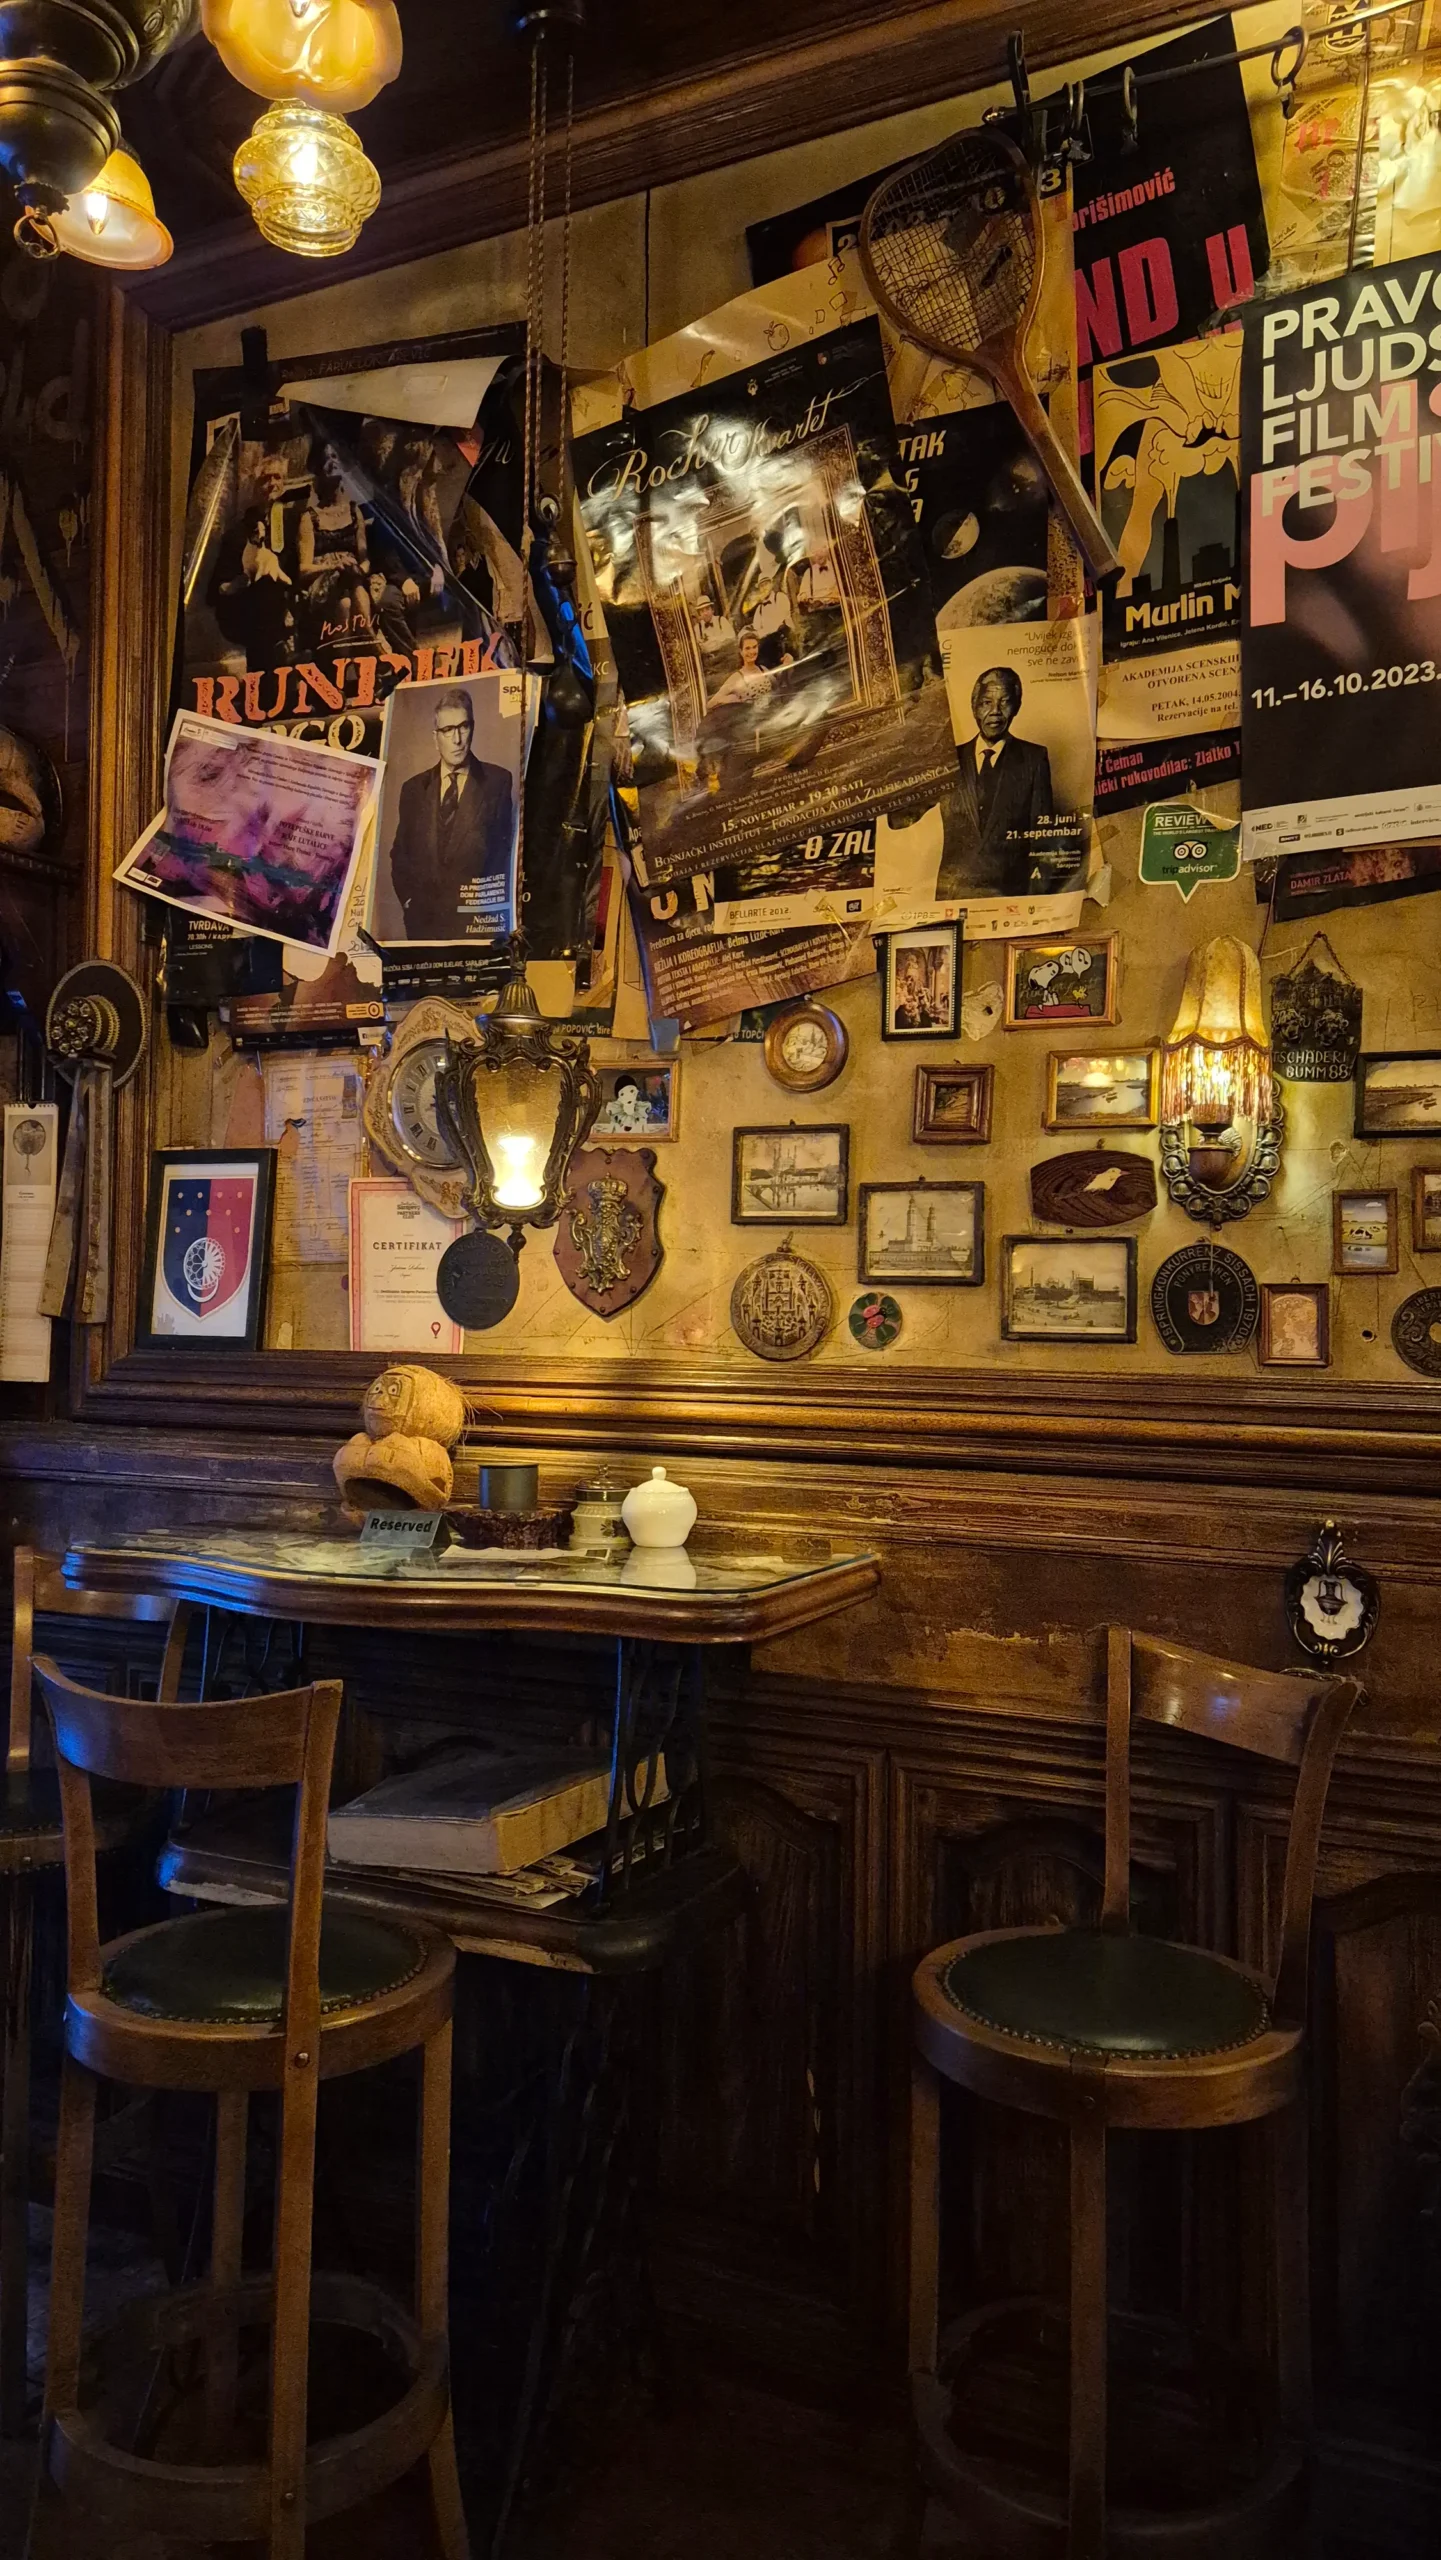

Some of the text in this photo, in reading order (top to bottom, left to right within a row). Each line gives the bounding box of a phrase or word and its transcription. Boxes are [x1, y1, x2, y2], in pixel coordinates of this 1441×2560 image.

[1262, 384, 1411, 465] FILM
[1262, 433, 1441, 517] FESTI
[1125, 592, 1214, 632] Murlin
[1142, 637, 1155, 645] Ana
[1184, 627, 1205, 636] Jelena
[1028, 658, 1043, 667] sve
[1122, 664, 1183, 682] AKADEMIJA
[1148, 672, 1206, 689] OTVORENA
[1151, 689, 1241, 712] PETAK, 14.05.2004.
[1157, 702, 1239, 723] Rezervacije na tel.
[1195, 745, 1232, 768] Zlatko
[721, 779, 864, 835] 15. NOVEMBAR 19.30 SATI
[819, 810, 864, 830] SARAJEVO
[1037, 815, 1053, 825] 28.
[1054, 813, 1077, 827] juni
[1006, 827, 1083, 840] 21. septembar
[1162, 864, 1215, 876] tripadvisor
[1290, 876, 1321, 890] DAMIR
[730, 907, 768, 921] BELLARTE
[1286, 1066, 1327, 1079] BUMM
[373, 1242, 442, 1250] CERTIFIKAT
[1224, 1253, 1256, 1302] SISSACH
[370, 1518, 433, 1533] Reserved
